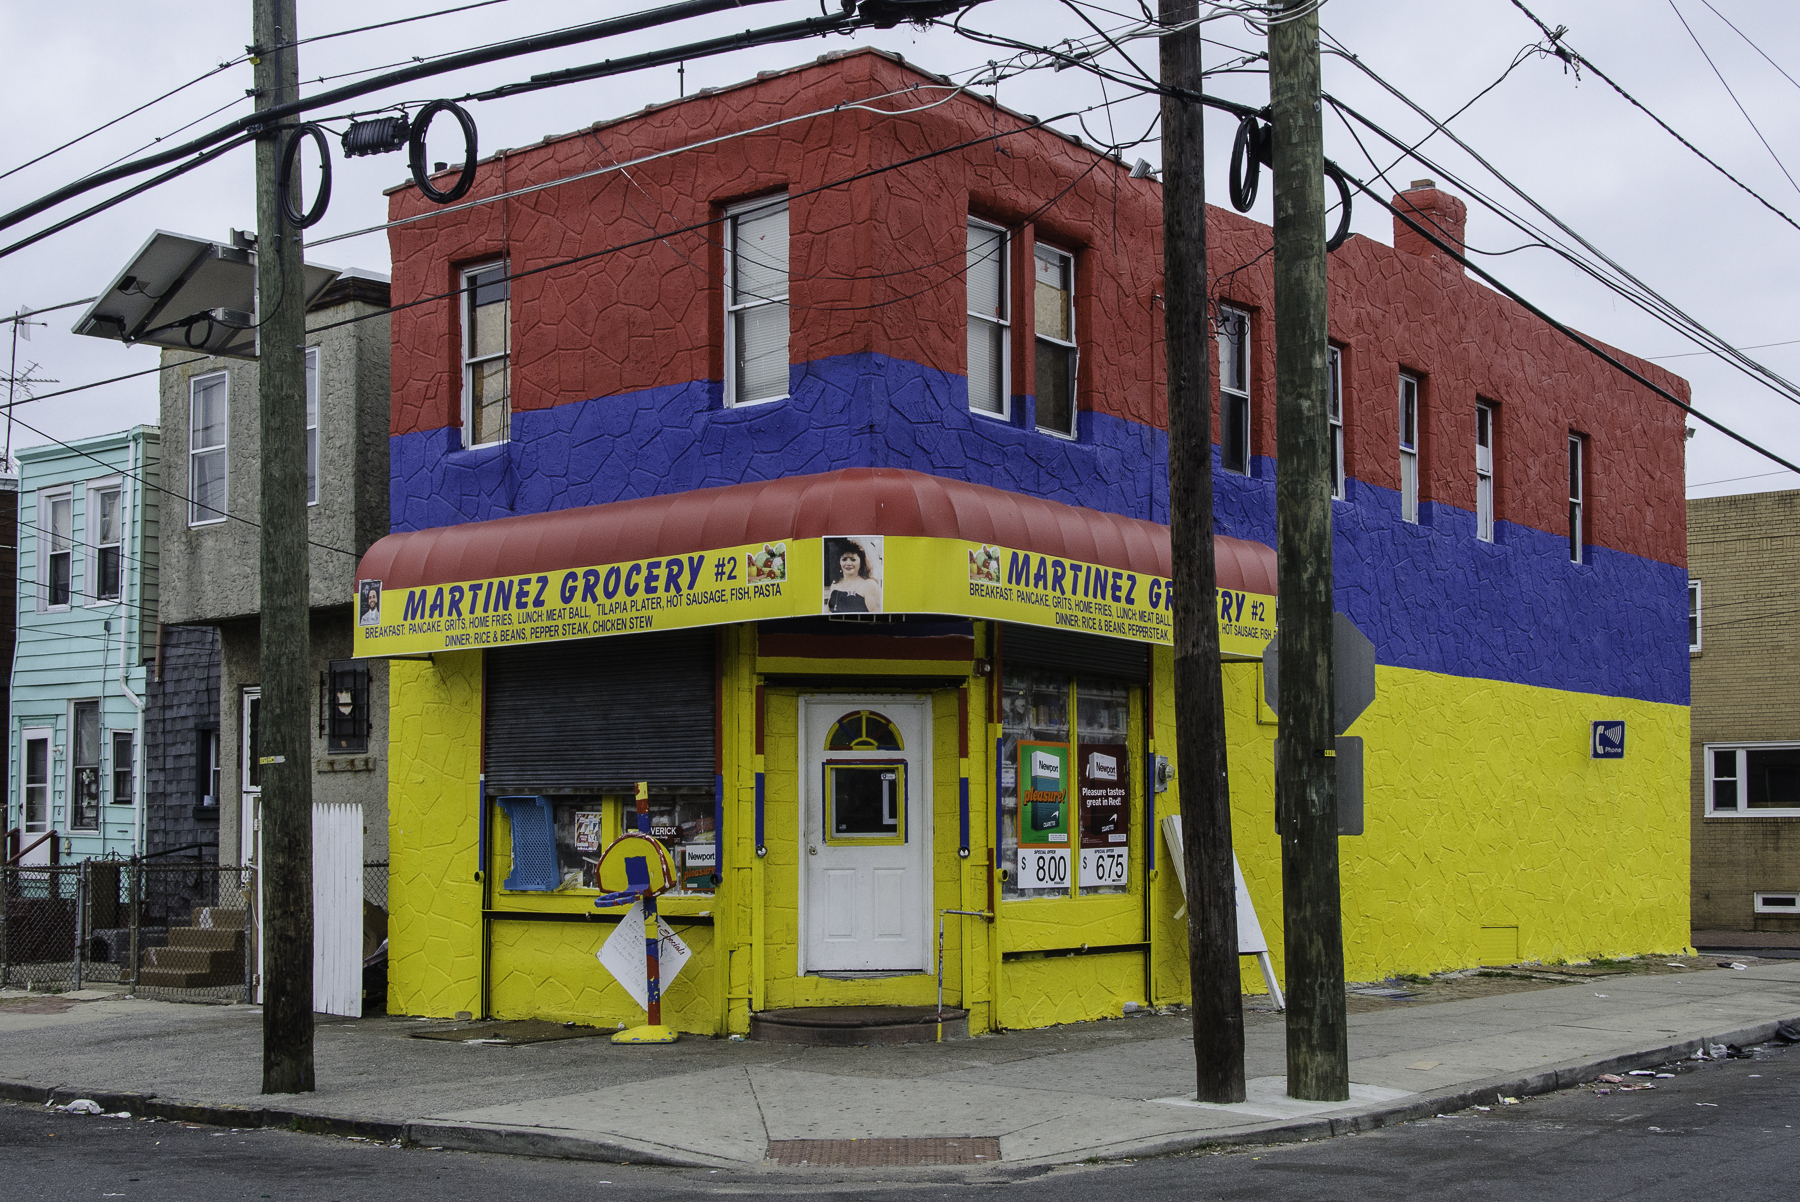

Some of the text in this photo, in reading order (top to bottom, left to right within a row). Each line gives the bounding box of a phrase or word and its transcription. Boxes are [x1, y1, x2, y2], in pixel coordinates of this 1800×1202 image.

[403, 555, 738, 622] MARTINEZ GROCERY #2
[1007, 551, 1265, 624] MARTINEZ GRRY #2
[365, 583, 782, 639] BREAKFAST: PANCAKE, GRITS, HOME FRIES, LUNCH: MEAT BALL, TILAPIA PLATER, HOT SAUSAGE, FISH, PASTA
[969, 583, 1014, 602] BREAKFAST:
[1016, 592, 1050, 609] PANCAKE,
[1052, 596, 1073, 612] GRITS,
[1074, 600, 1093, 613] HOME
[1094, 604, 1114, 618] FRIES,
[1116, 608, 1137, 622] LUNCH:
[1138, 610, 1154, 624] MEAT
[1156, 612, 1172, 628] BALL,
[1222, 623, 1232, 635] HOT
[1234, 625, 1260, 640] SAUSAGE,
[1055, 612, 1081, 628] DINNER:
[1082, 617, 1097, 630] RICE
[1098, 620, 1103, 630] &
[1104, 621, 1127, 636] BEANS,
[445, 615, 654, 648] DINNER: RICE & BEANS, PEPPER STEAK, CHICKEN STEW
[1038, 760, 1059, 773] Newport
[1096, 761, 1116, 774] Newport
[1023, 786, 1066, 806] pleasure!
[1082, 788, 1126, 796] Pleasure tastes
[1086, 797, 1122, 808] great in Red!
[688, 852, 715, 862] Newport
[1022, 856, 1066, 884] $ 8.00
[1082, 854, 1124, 882] $ 6.75
